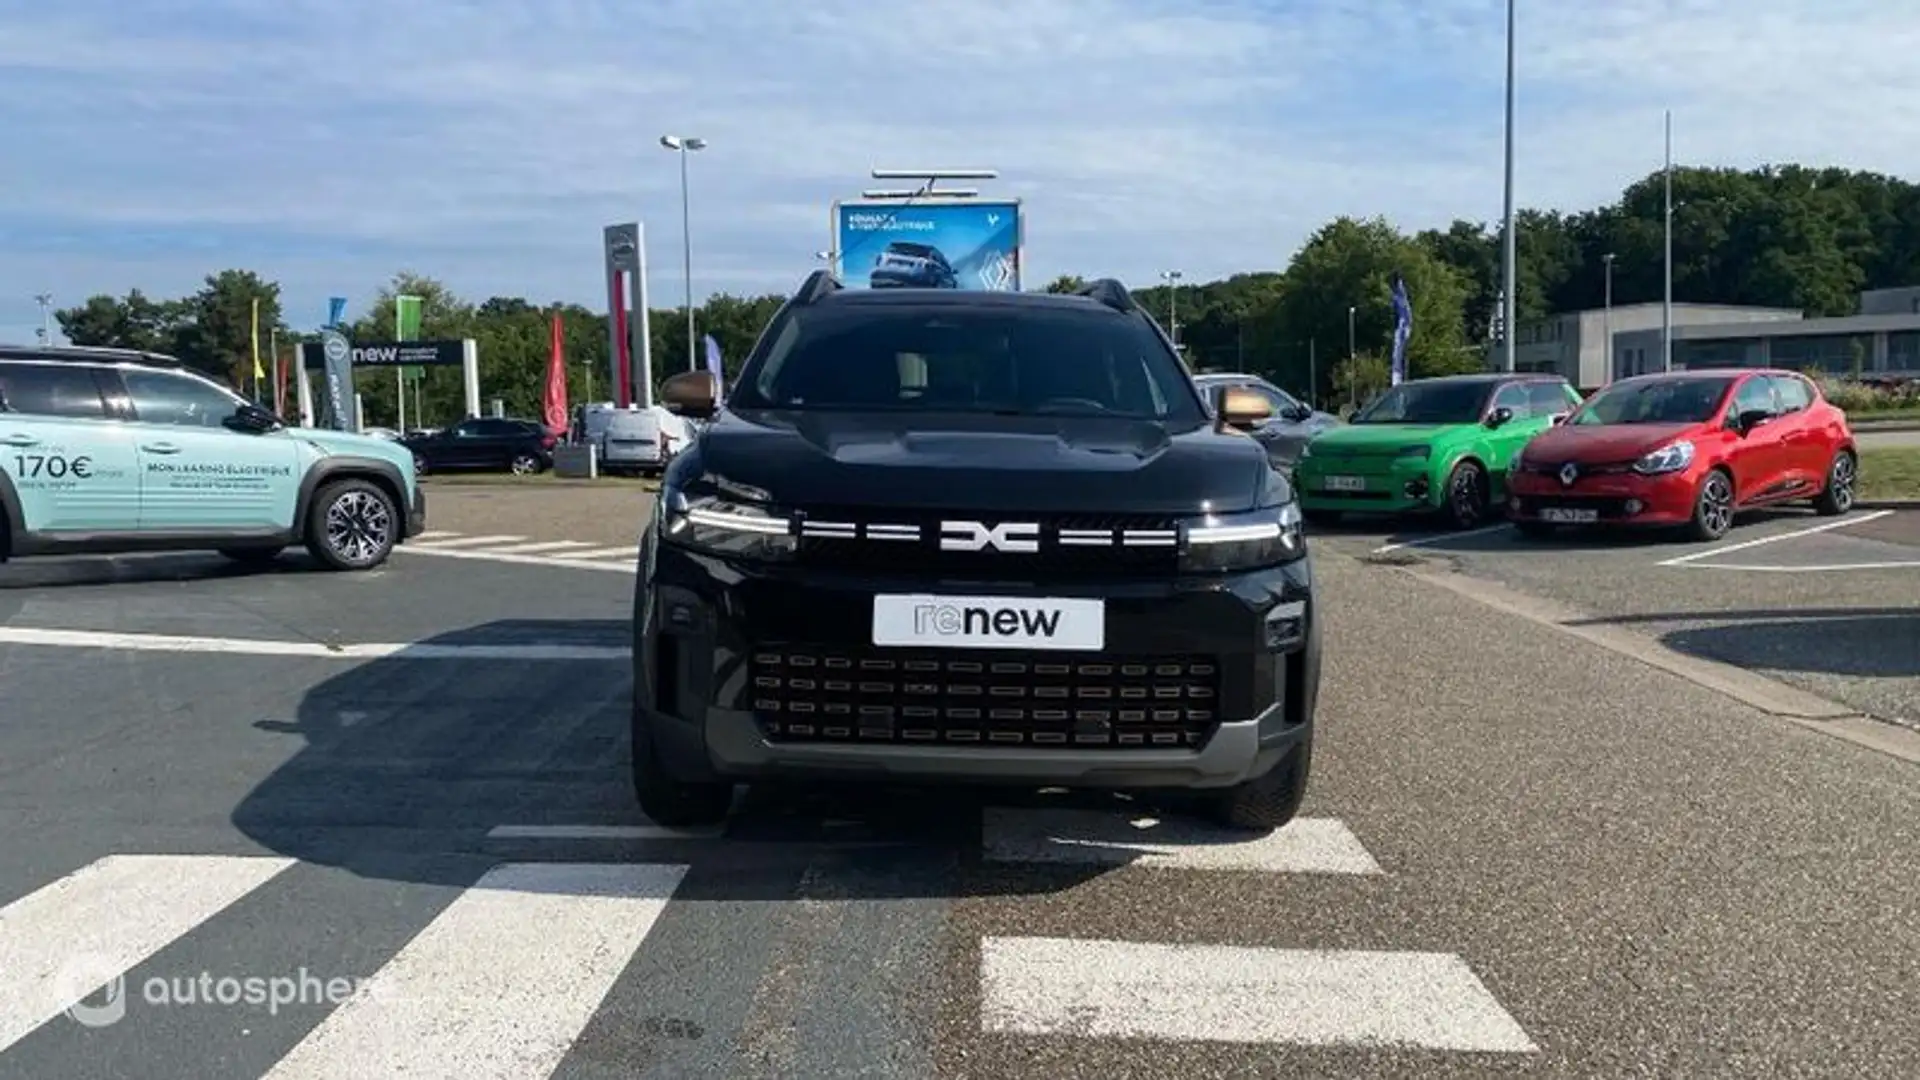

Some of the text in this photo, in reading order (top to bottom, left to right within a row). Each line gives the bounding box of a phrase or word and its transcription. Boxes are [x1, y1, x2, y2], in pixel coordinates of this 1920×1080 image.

[352, 347, 397, 361] new
[14, 455, 93, 478] 170€
[914, 604, 1062, 637] renew
